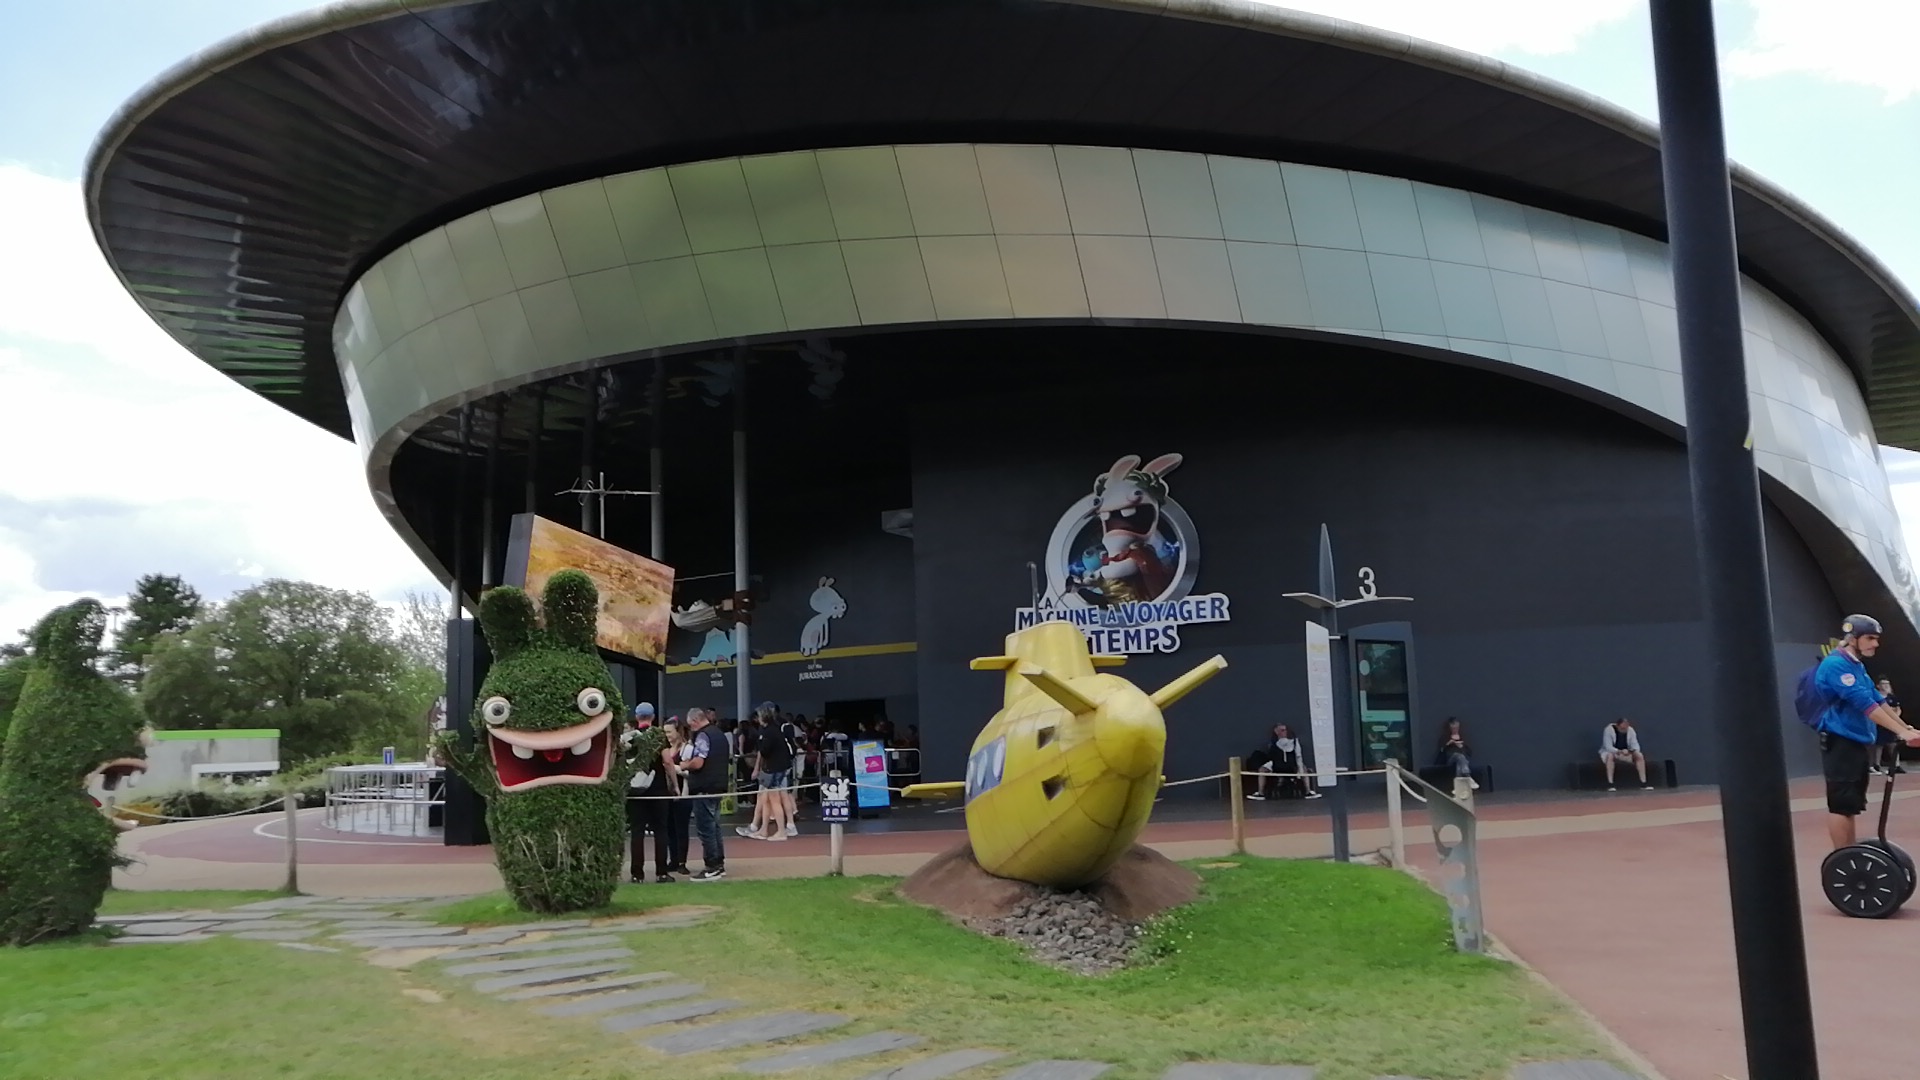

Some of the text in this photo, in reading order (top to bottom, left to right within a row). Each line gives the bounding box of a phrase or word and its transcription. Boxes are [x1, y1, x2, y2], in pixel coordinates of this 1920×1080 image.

[1358, 566, 1377, 599] 3
[1121, 597, 1226, 624] VOYAGER
[1090, 625, 1177, 653] TEMPS
